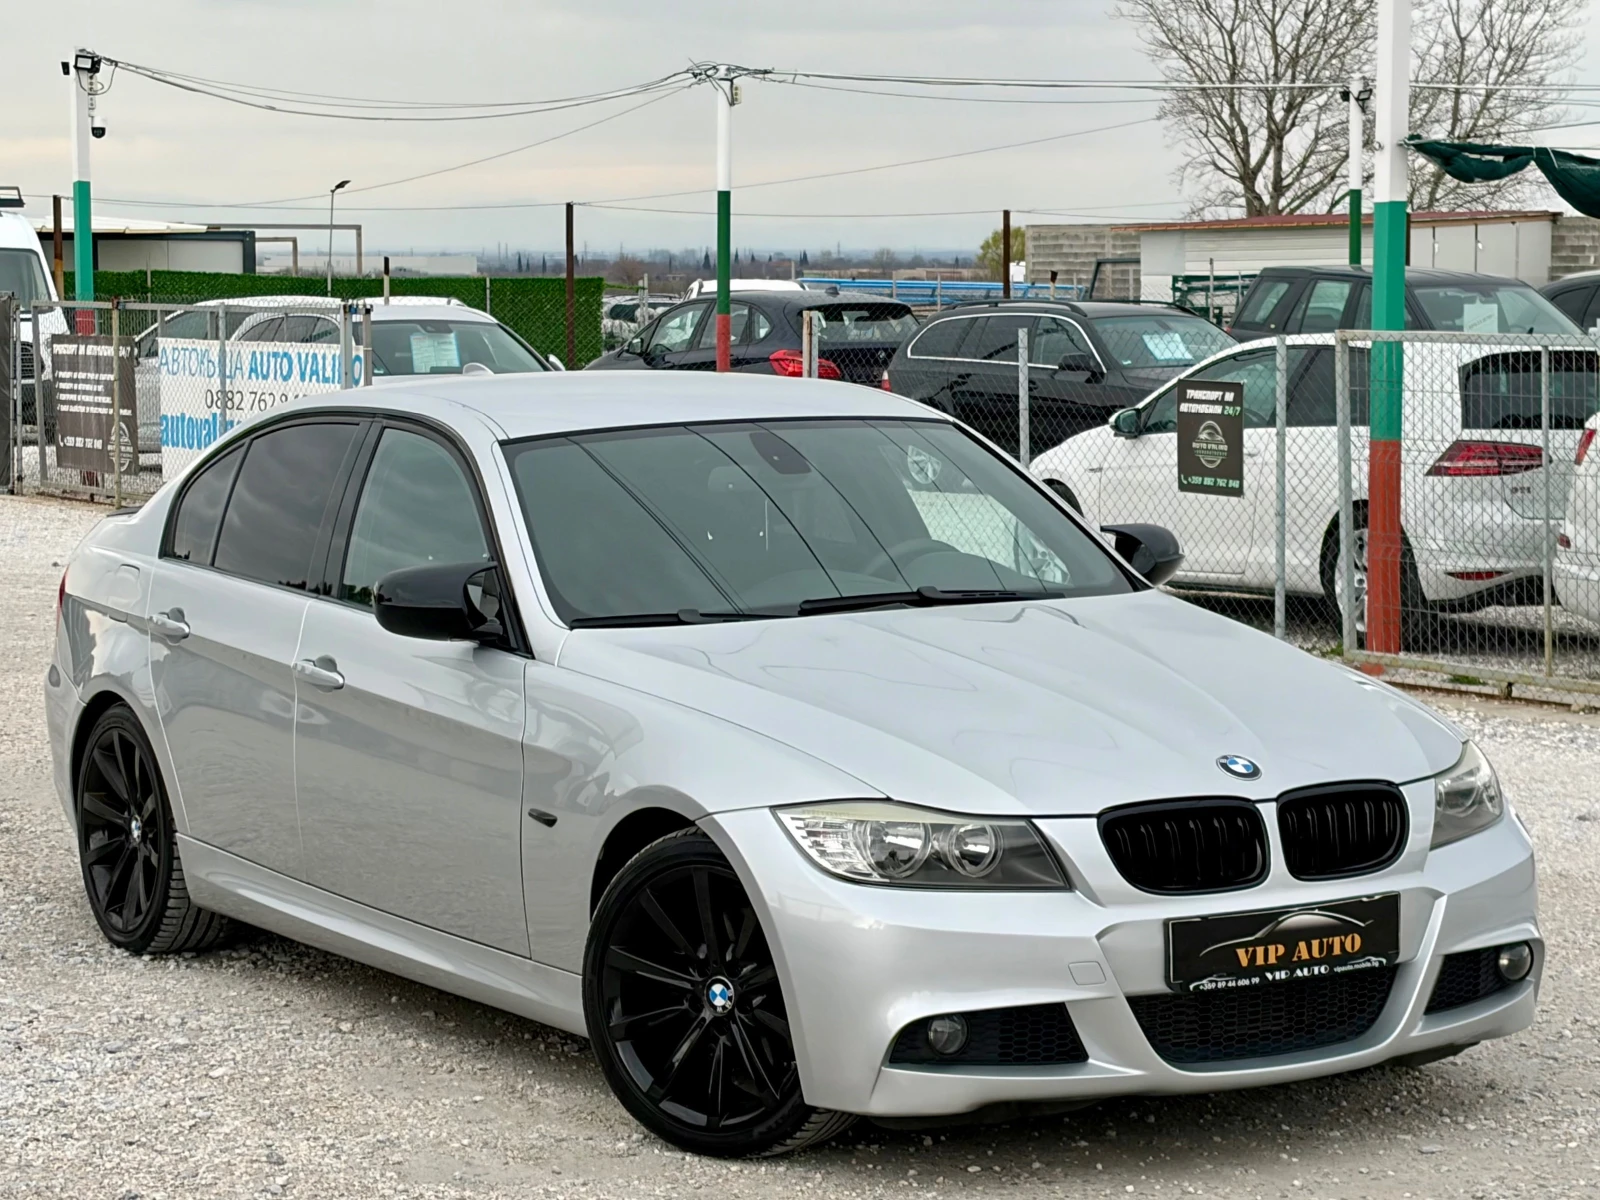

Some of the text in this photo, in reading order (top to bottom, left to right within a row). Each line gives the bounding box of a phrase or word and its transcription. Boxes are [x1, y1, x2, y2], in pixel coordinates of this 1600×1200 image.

[248, 350, 293, 382] AUTO
[297, 352, 363, 387] VALIO
[205, 389, 244, 411] 0882
[1224, 405, 1241, 416] 24/7
[1235, 932, 1361, 967] VIP AUTO
[1264, 969, 1290, 981] VIP
[1293, 964, 1329, 977] AUTO
